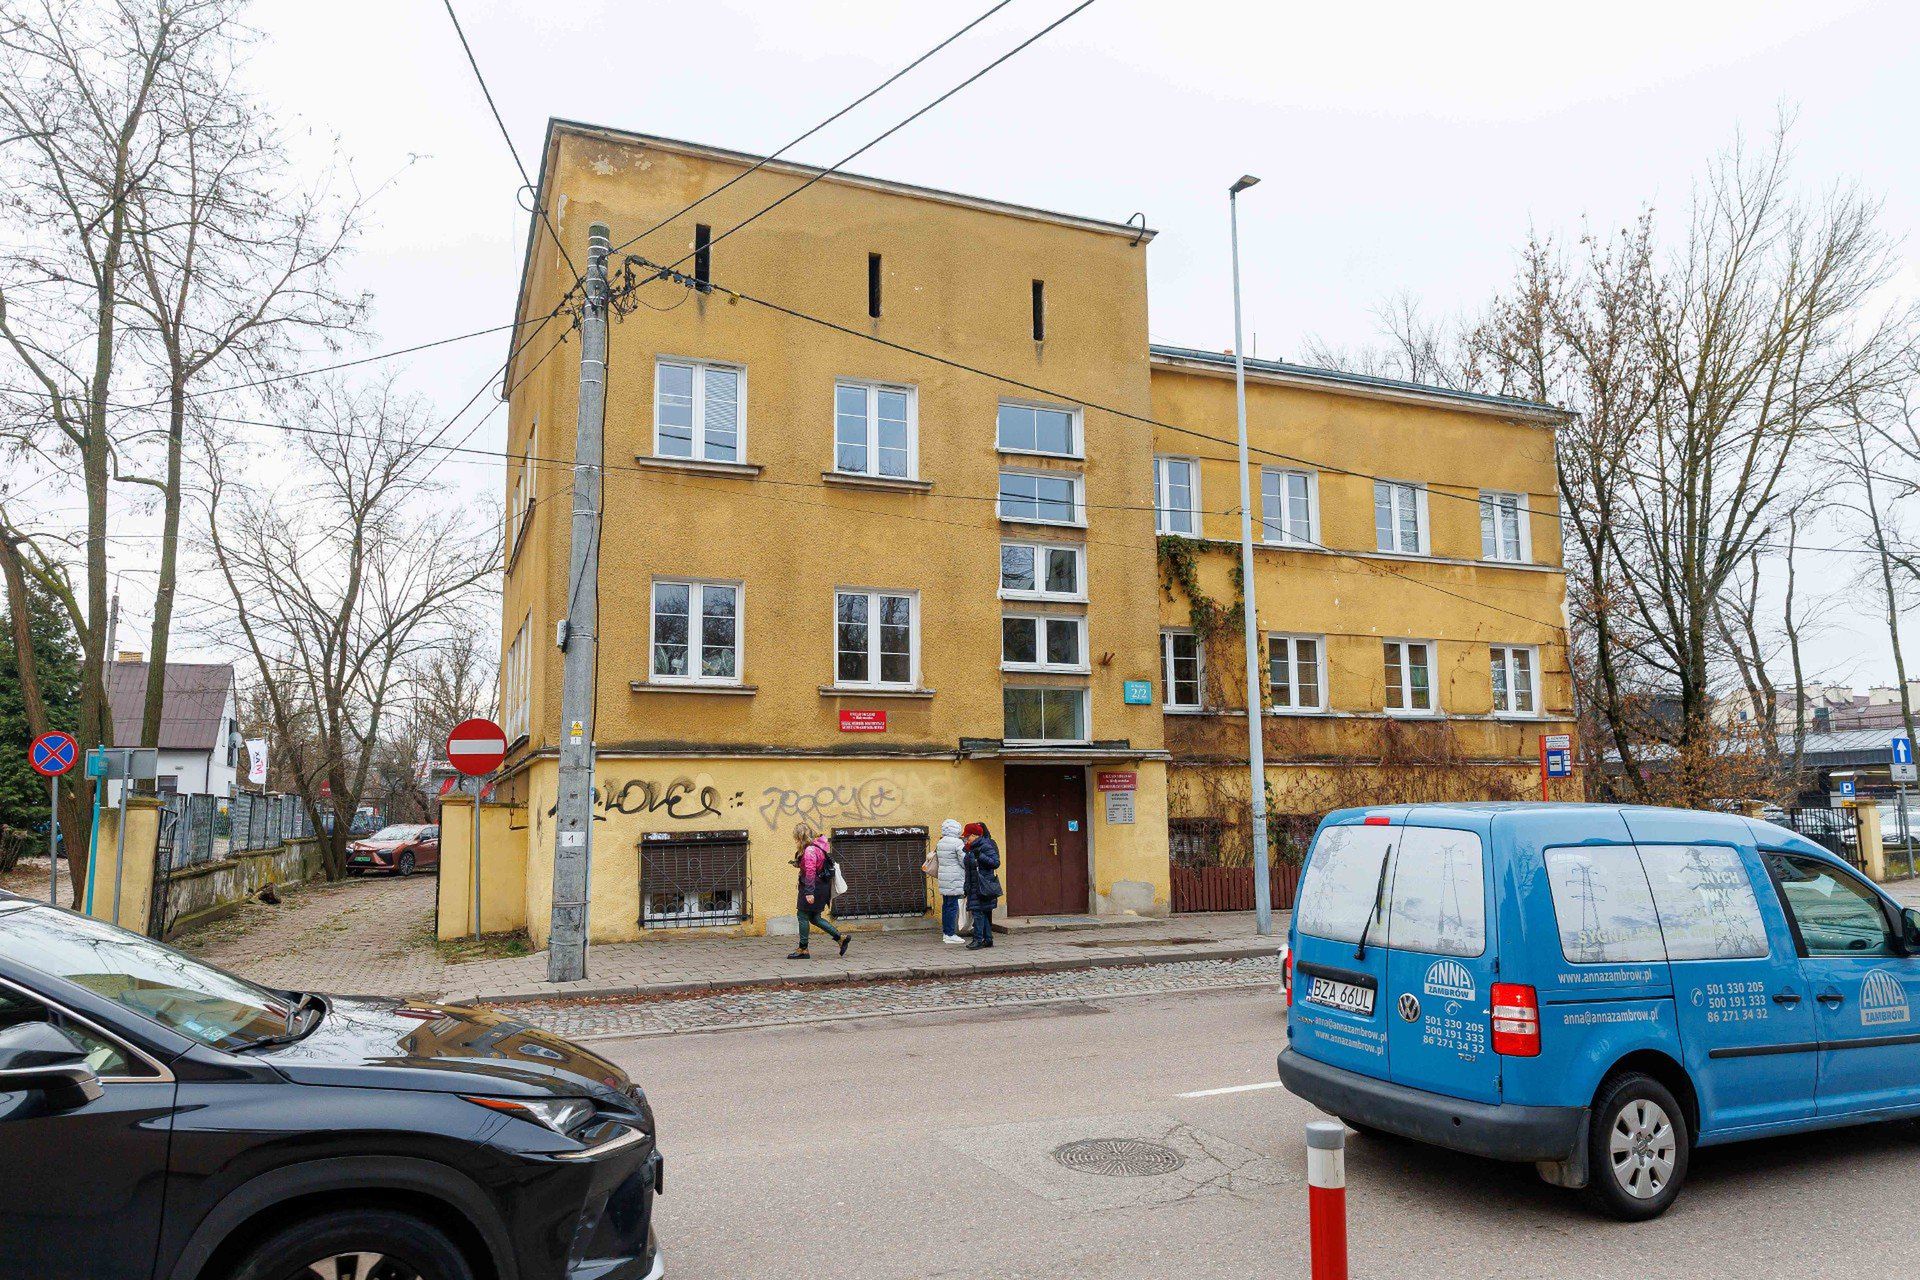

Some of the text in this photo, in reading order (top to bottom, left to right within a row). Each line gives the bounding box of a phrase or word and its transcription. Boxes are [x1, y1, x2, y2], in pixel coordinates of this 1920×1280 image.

[1428, 961, 1471, 988] ANNA
[1558, 968, 1653, 984] www.annazambrow.pl
[1313, 979, 1336, 1001] BZA
[1340, 985, 1370, 1009] 66UL
[1428, 985, 1469, 998] ZAMBRÓW
[1706, 981, 1764, 995] 501 330 205
[1863, 972, 1904, 1007] ANNA
[1709, 994, 1766, 1009] 500 191 333
[1425, 1015, 1484, 1033] 501 330 205
[1563, 1009, 1659, 1025] anna@annazambrow.pl
[1707, 1008, 1768, 1023] 86 271 34 32
[1425, 1025, 1484, 1043] 500 191 333
[1423, 1034, 1485, 1054] 86 271 34 32
